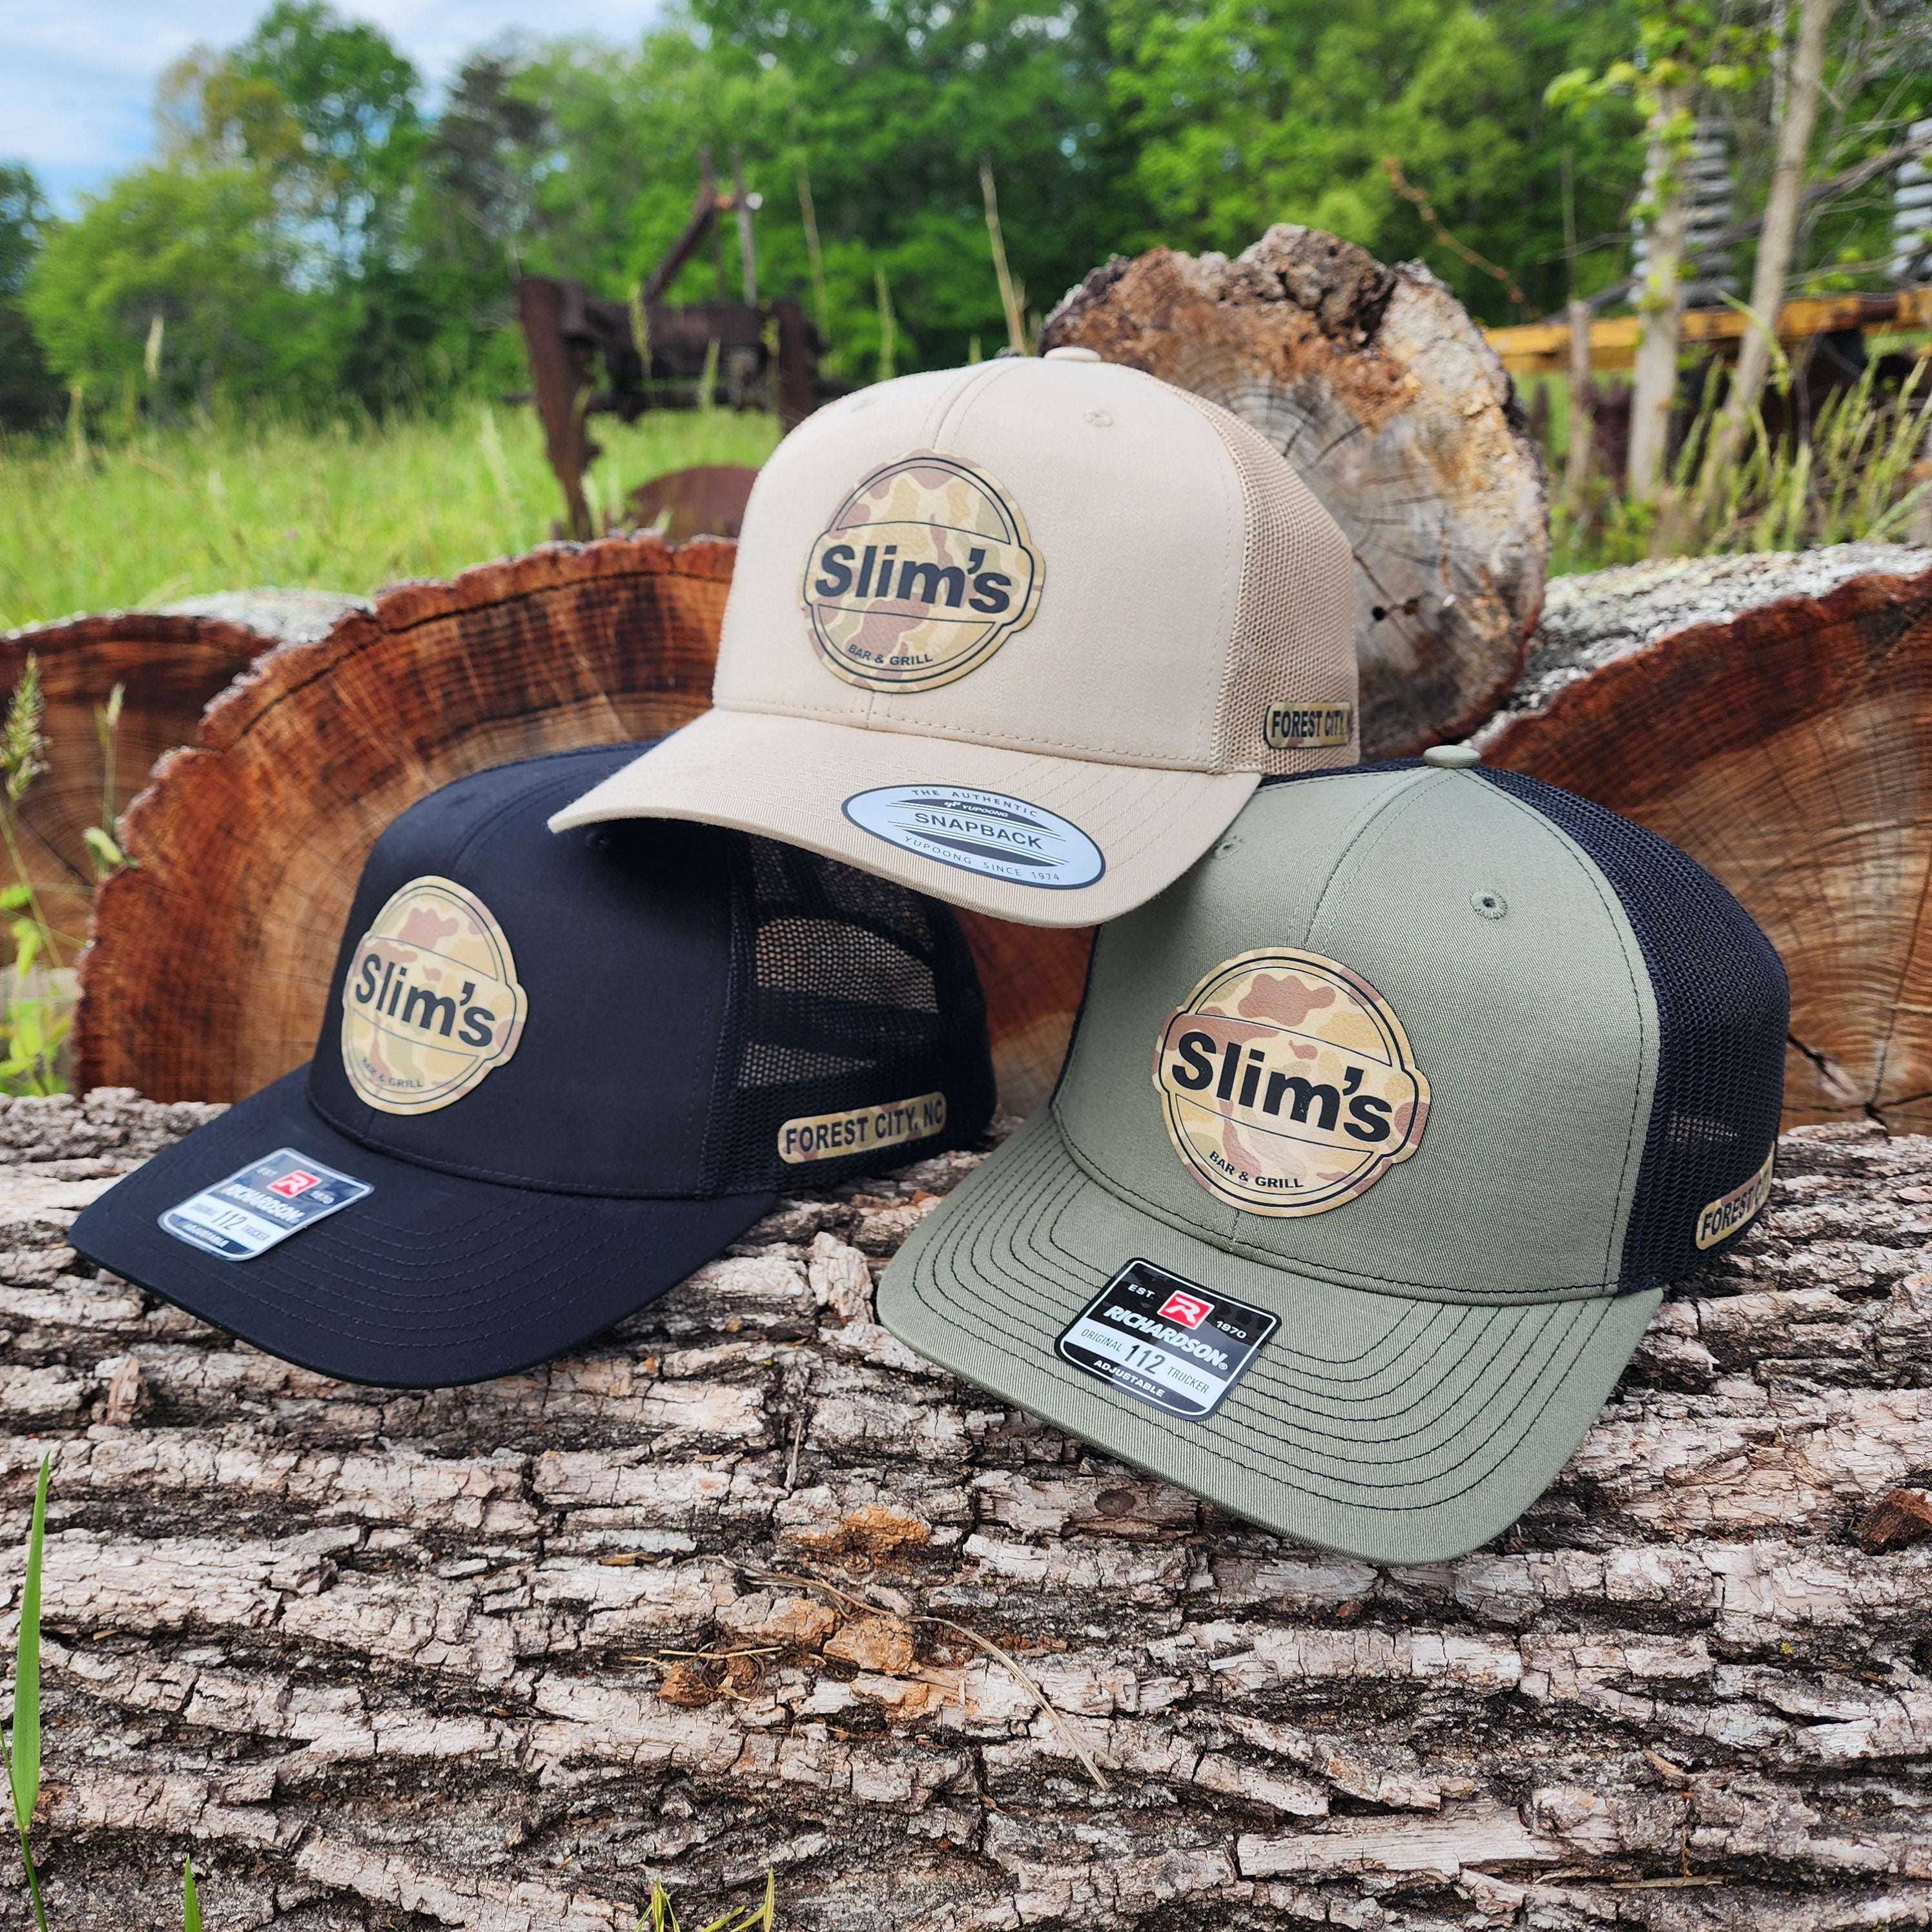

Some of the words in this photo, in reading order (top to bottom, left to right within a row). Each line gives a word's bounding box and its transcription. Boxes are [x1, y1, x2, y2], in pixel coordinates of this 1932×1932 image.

[815, 544, 1012, 614] Slim's
[848, 644, 870, 661] BAR
[874, 654, 884, 664] &
[890, 653, 933, 666] GRILL
[1271, 710, 1323, 738] FOREST
[952, 791, 1038, 817] AUTHENTIC
[961, 804, 1009, 818] YUPOONG
[914, 812, 1045, 850] SNAPBACK
[904, 835, 972, 865] YUPOONG
[983, 861, 1022, 877] SINCE
[1031, 871, 1060, 881] 1974
[356, 953, 496, 1047] Slim's
[1171, 1031, 1393, 1143] Slim's
[785, 1116, 869, 1155] FOREST
[874, 1105, 918, 1139] CITY,
[923, 1099, 943, 1127] NC
[1209, 1150, 1235, 1176] BAR
[1238, 1171, 1249, 1182] &
[1255, 1175, 1304, 1189] GRILL
[211, 1209, 248, 1231] 112
[1700, 1184, 1755, 1241] FOREST
[1216, 1320, 1248, 1339] 1970
[1080, 1328, 1122, 1353] ORIGINAL
[1124, 1344, 1166, 1375] 112
[1167, 1366, 1209, 1394] TRUCKER
[1093, 1359, 1166, 1397] ADJUSTABLE
